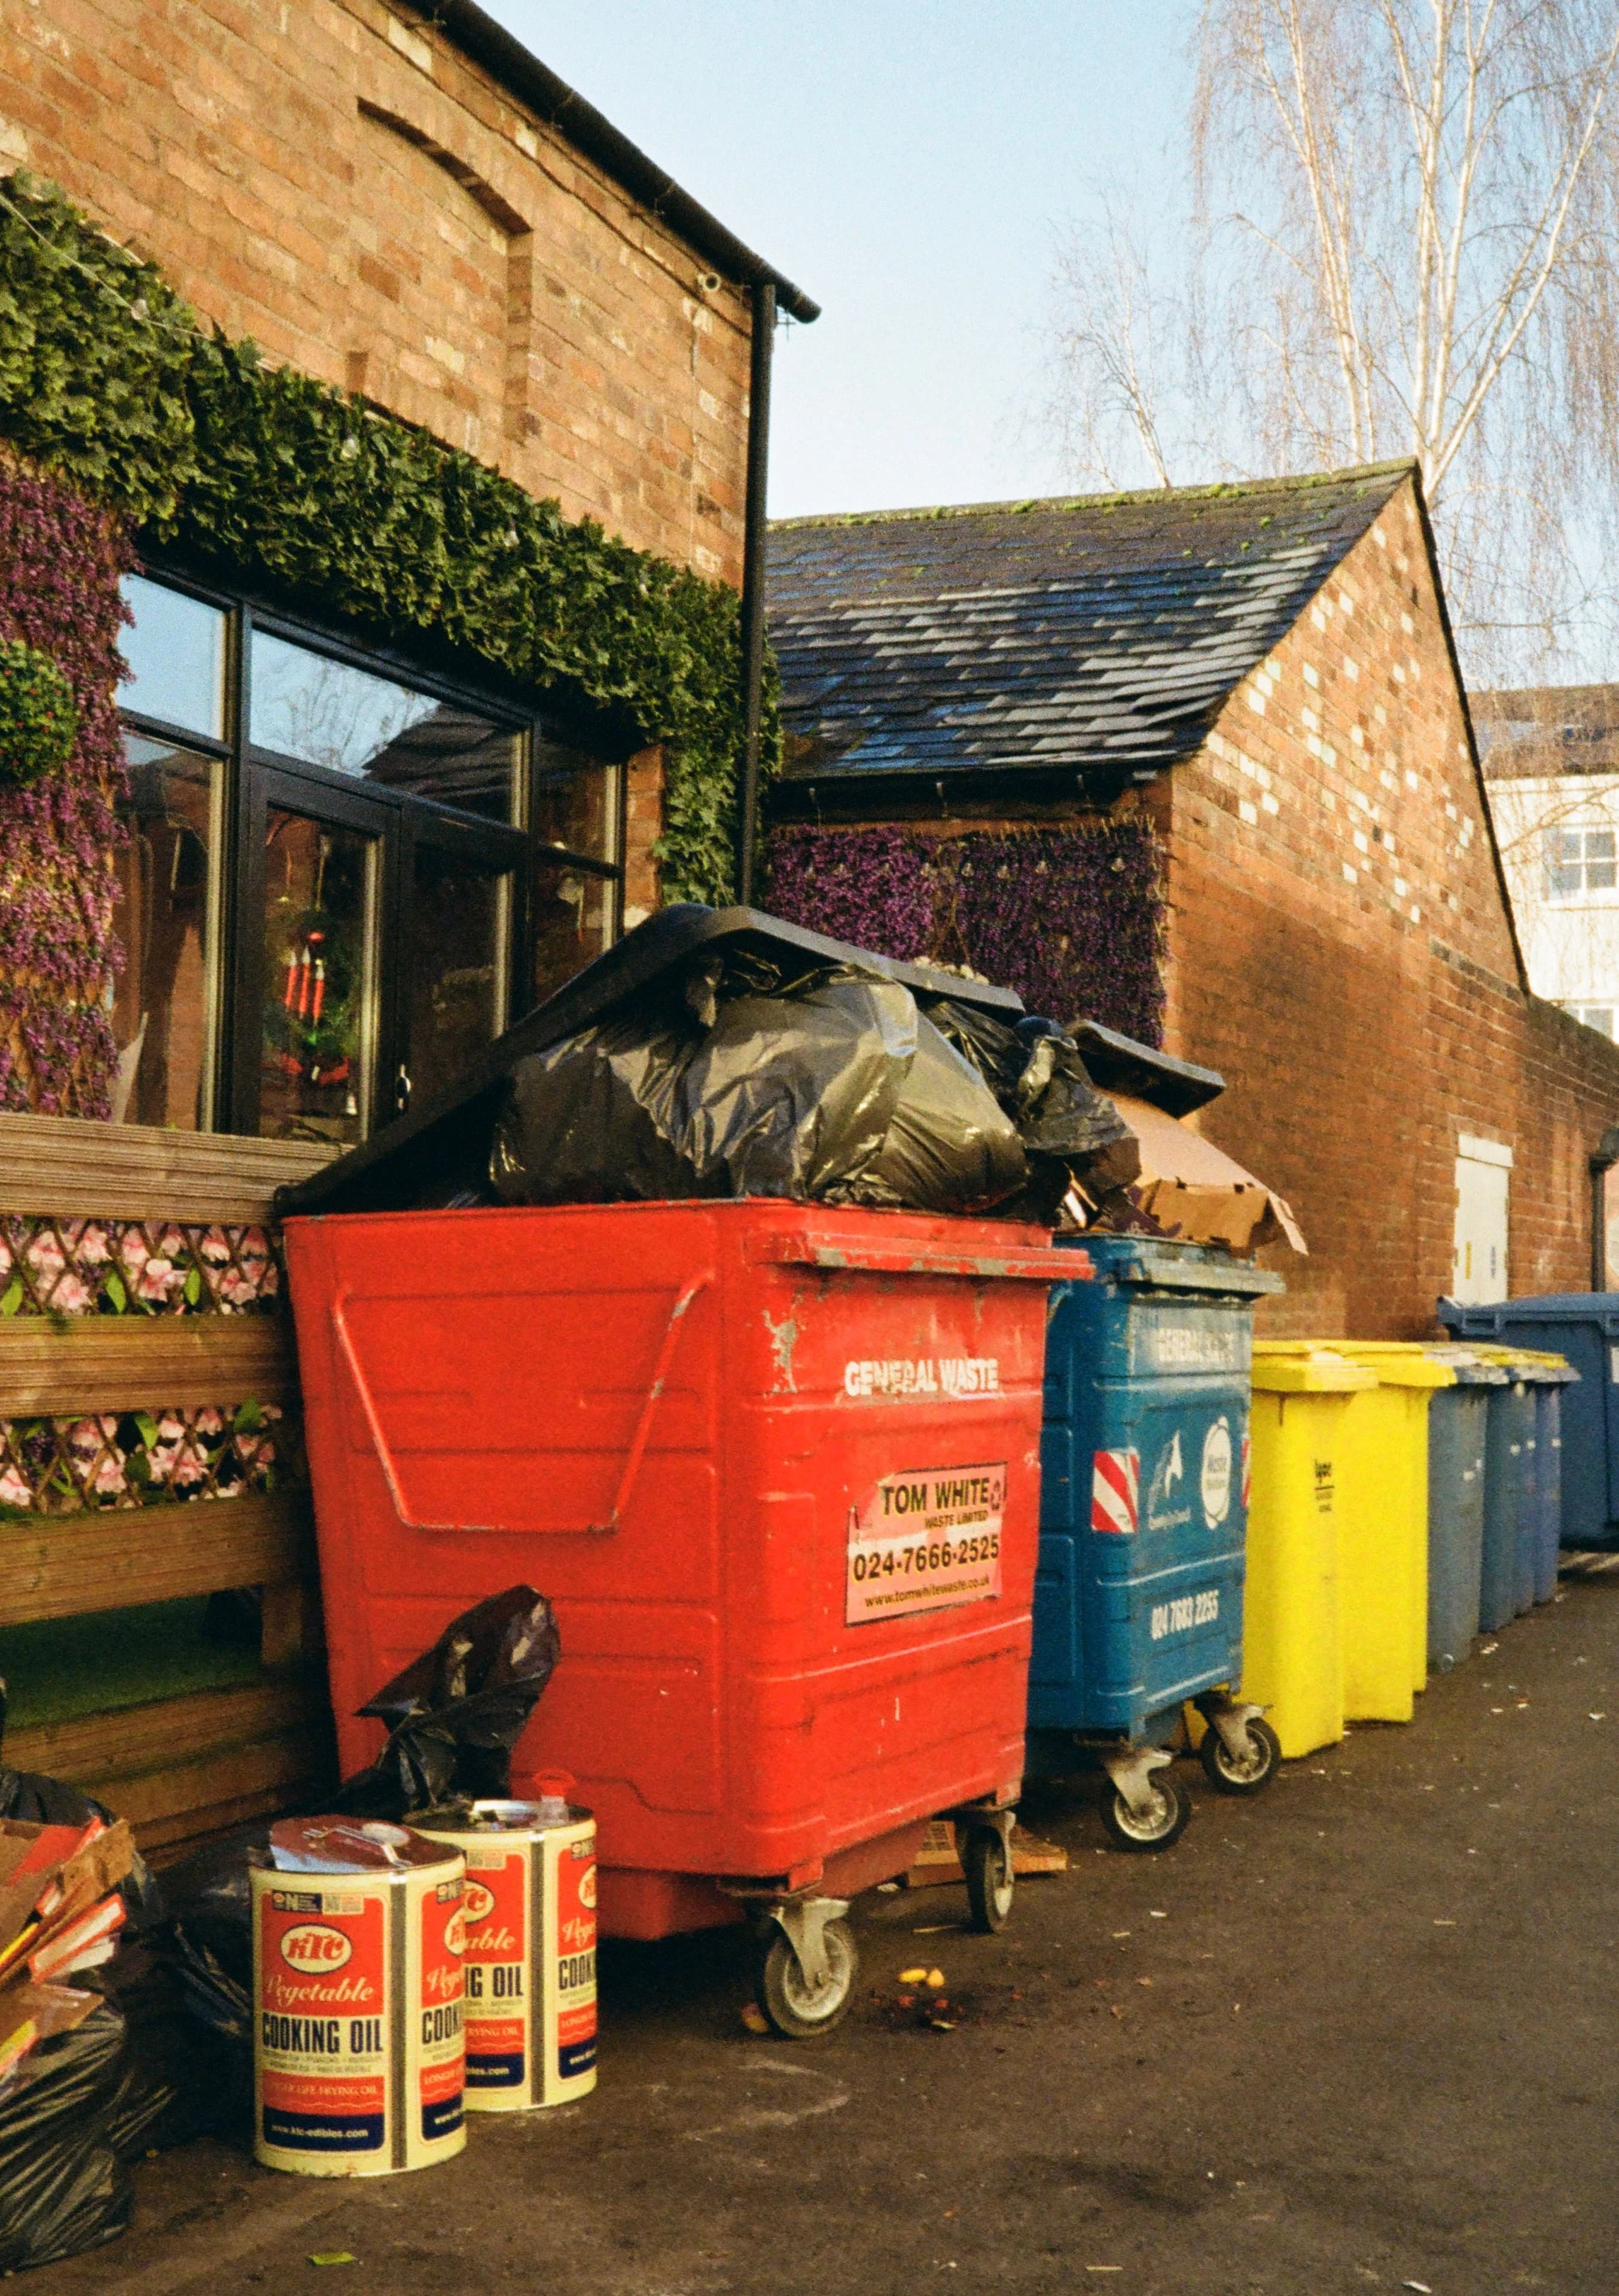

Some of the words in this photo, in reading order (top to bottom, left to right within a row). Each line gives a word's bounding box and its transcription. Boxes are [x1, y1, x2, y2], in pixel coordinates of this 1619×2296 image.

[844, 1360, 938, 1396] GENERAL
[939, 1358, 999, 1391] WASTE
[881, 1483, 927, 1516] TOM
[935, 1477, 990, 1510] WHITE
[925, 1514, 955, 1529] WASTE
[957, 1510, 989, 1525] LIMITED
[286, 1932, 345, 1961] KTC
[267, 1975, 374, 2007] Vegetable
[493, 1965, 524, 1998] OIL
[263, 2011, 340, 2054] COOKING
[350, 2019, 383, 2054] OIL
